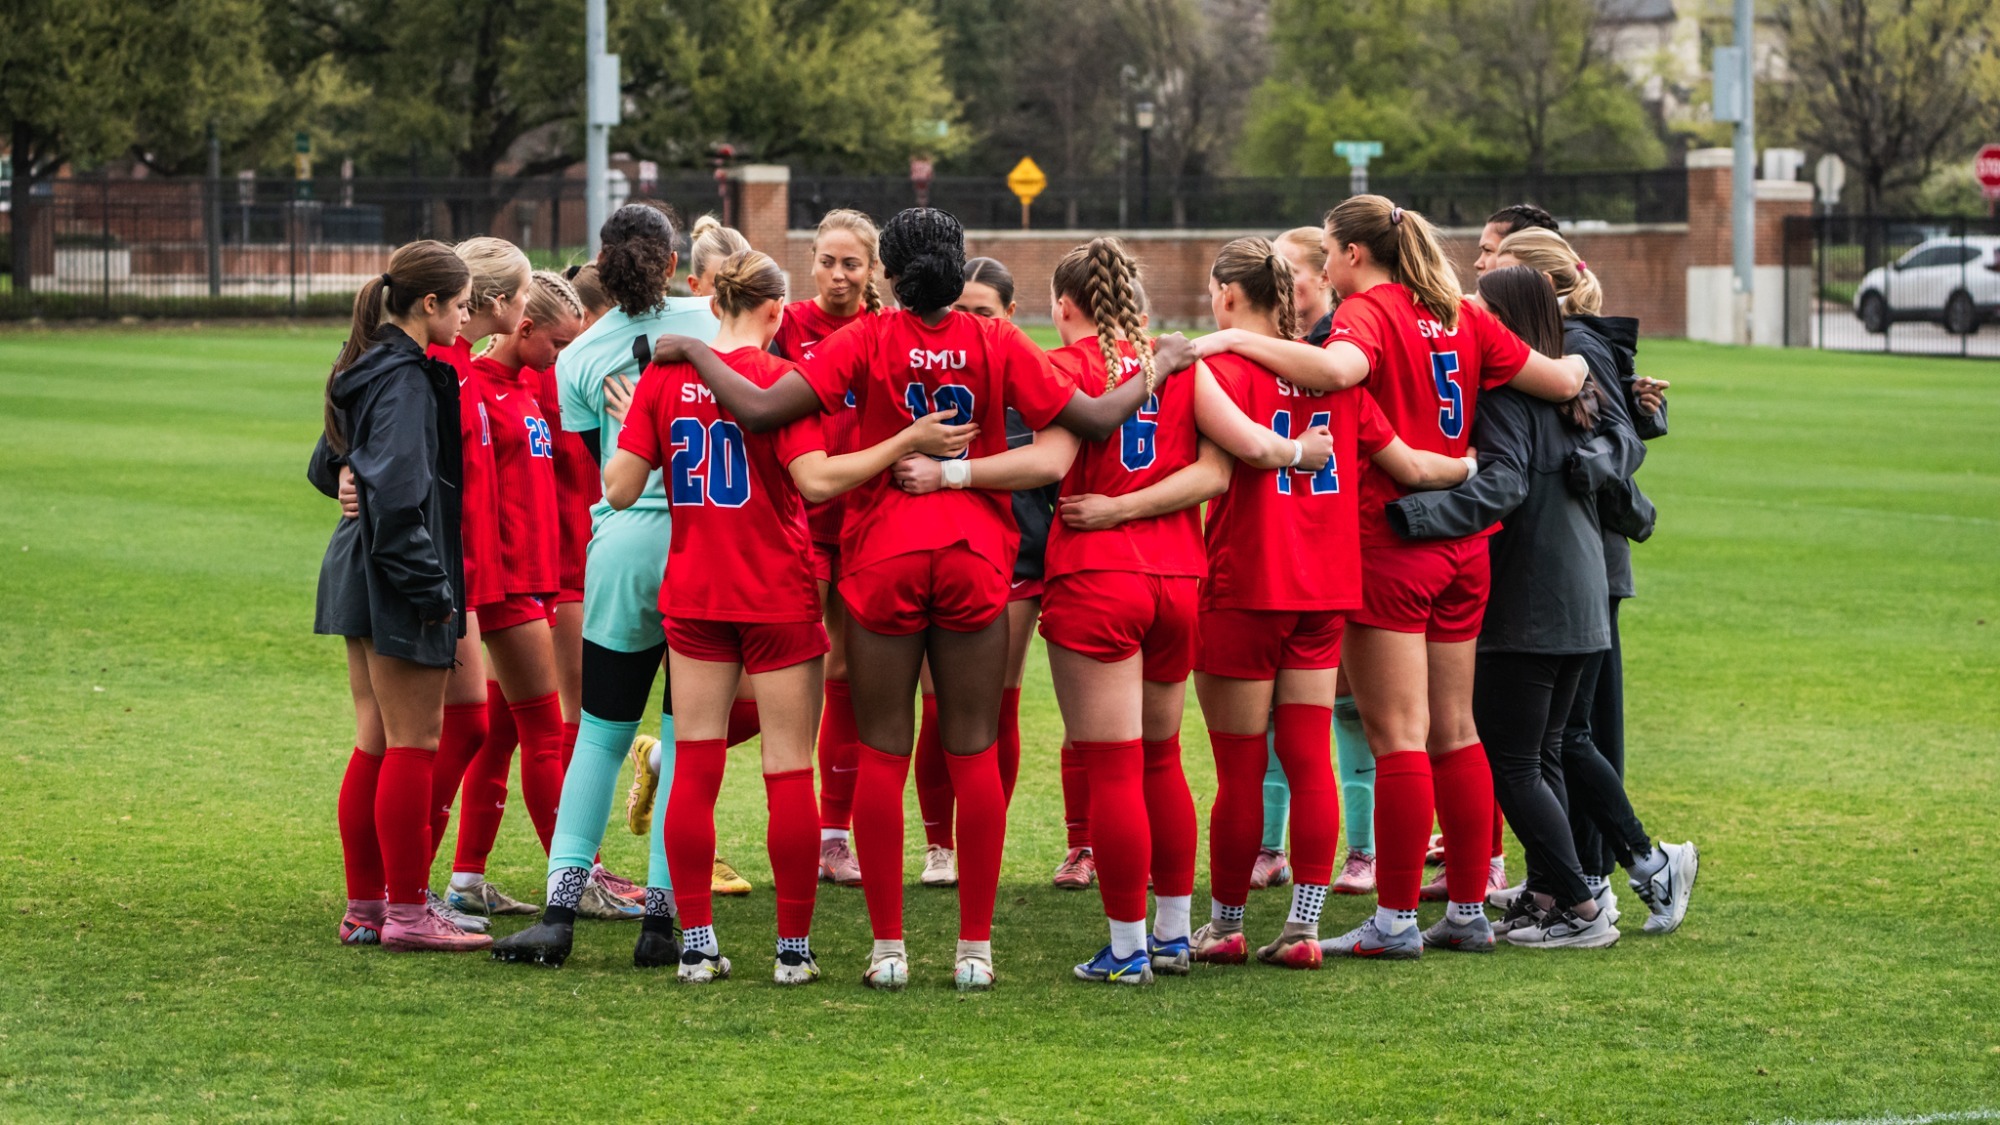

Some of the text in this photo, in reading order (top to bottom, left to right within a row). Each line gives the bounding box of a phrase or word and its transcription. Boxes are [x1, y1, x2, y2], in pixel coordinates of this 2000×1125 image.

[681, 383, 716, 403] SM
[909, 348, 966, 369] SMU
[1430, 351, 1463, 438] 5
[671, 417, 751, 508] 20
[1121, 392, 1159, 472] 6
[1272, 409, 1339, 495] 14
